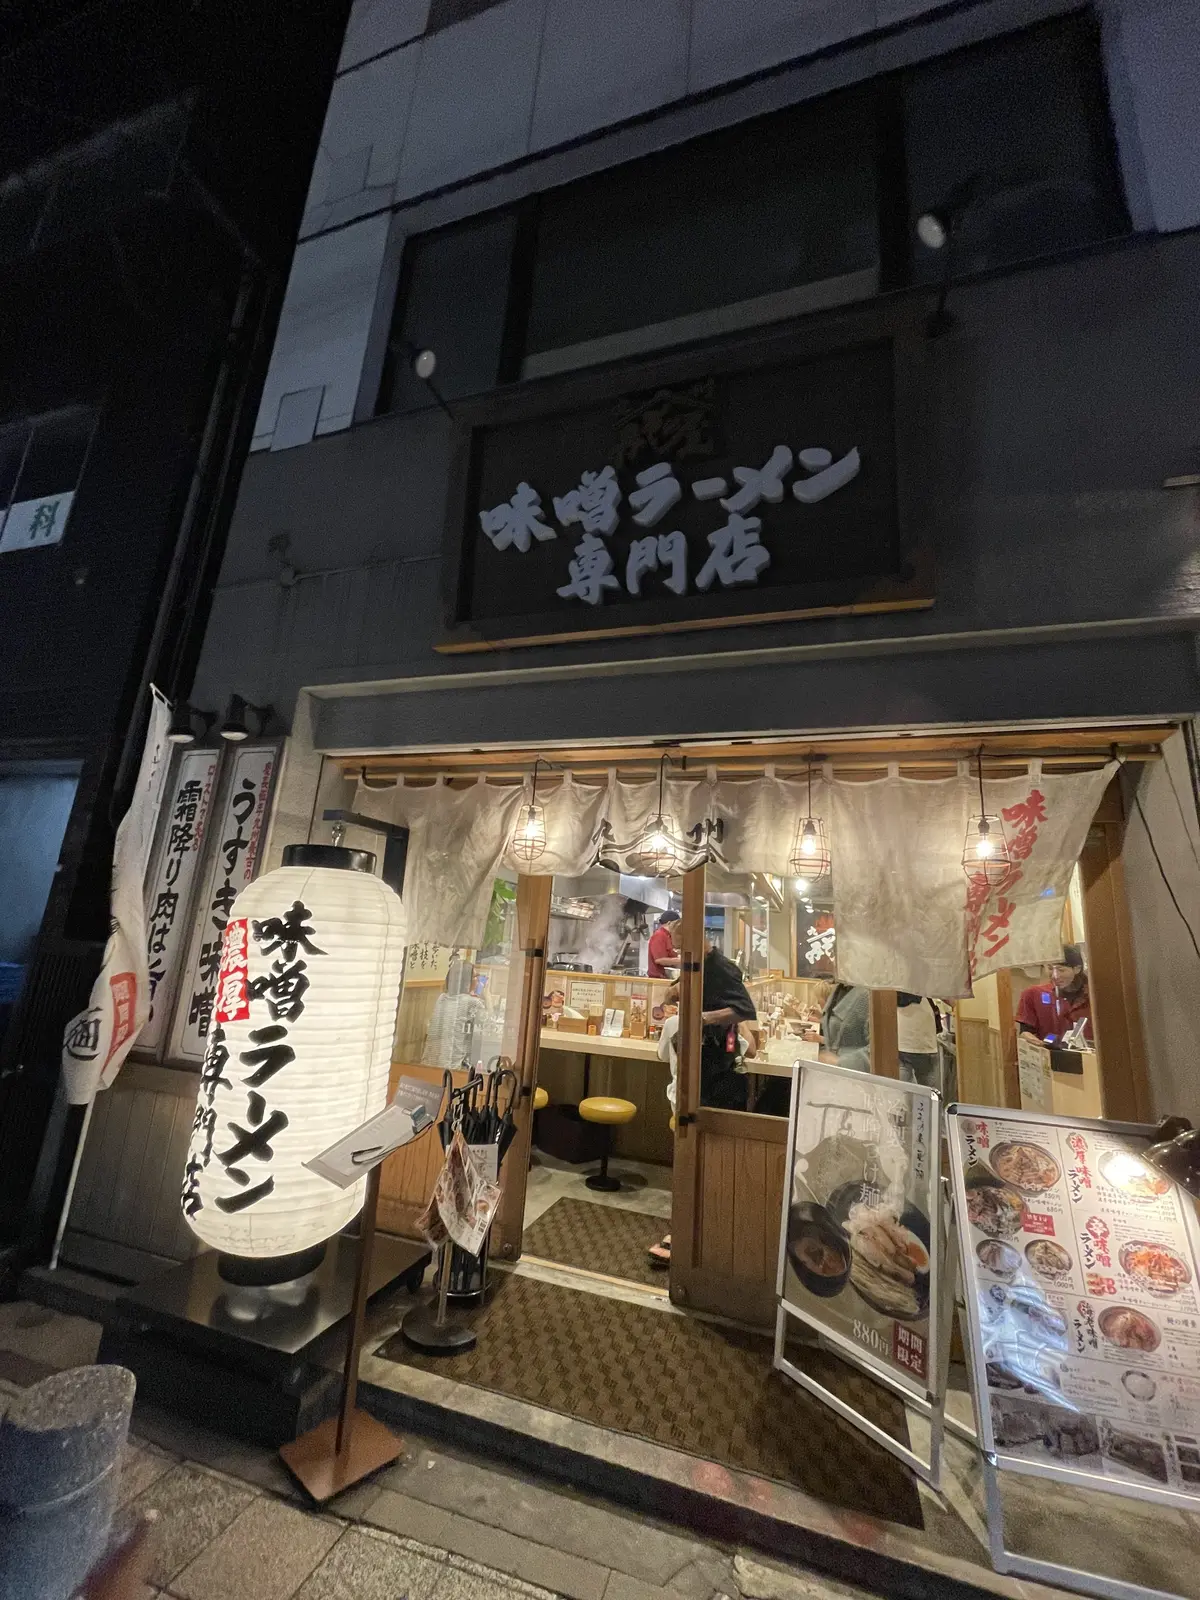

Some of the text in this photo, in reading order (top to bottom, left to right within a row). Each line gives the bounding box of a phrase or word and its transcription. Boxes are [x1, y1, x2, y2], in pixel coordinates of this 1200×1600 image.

[478, 445, 861, 553] 味噌ラーメン
[556, 513, 771, 606] 専門店
[981, 788, 1048, 957] 味噌ラーメン
[216, 921, 248, 1021] 濃厚
[213, 899, 329, 1215] 味噌ラーメン
[965, 1135, 978, 1166] ラーメン
[975, 1121, 990, 1148] 味噌
[1068, 1169, 1083, 1203] ラーメン
[1080, 1233, 1096, 1270] ラーメン
[852, 1319, 889, 1356] 880円
[898, 1326, 923, 1353] 期間
[1073, 1319, 1086, 1353] ラーメン
[897, 1345, 923, 1373] 限定
